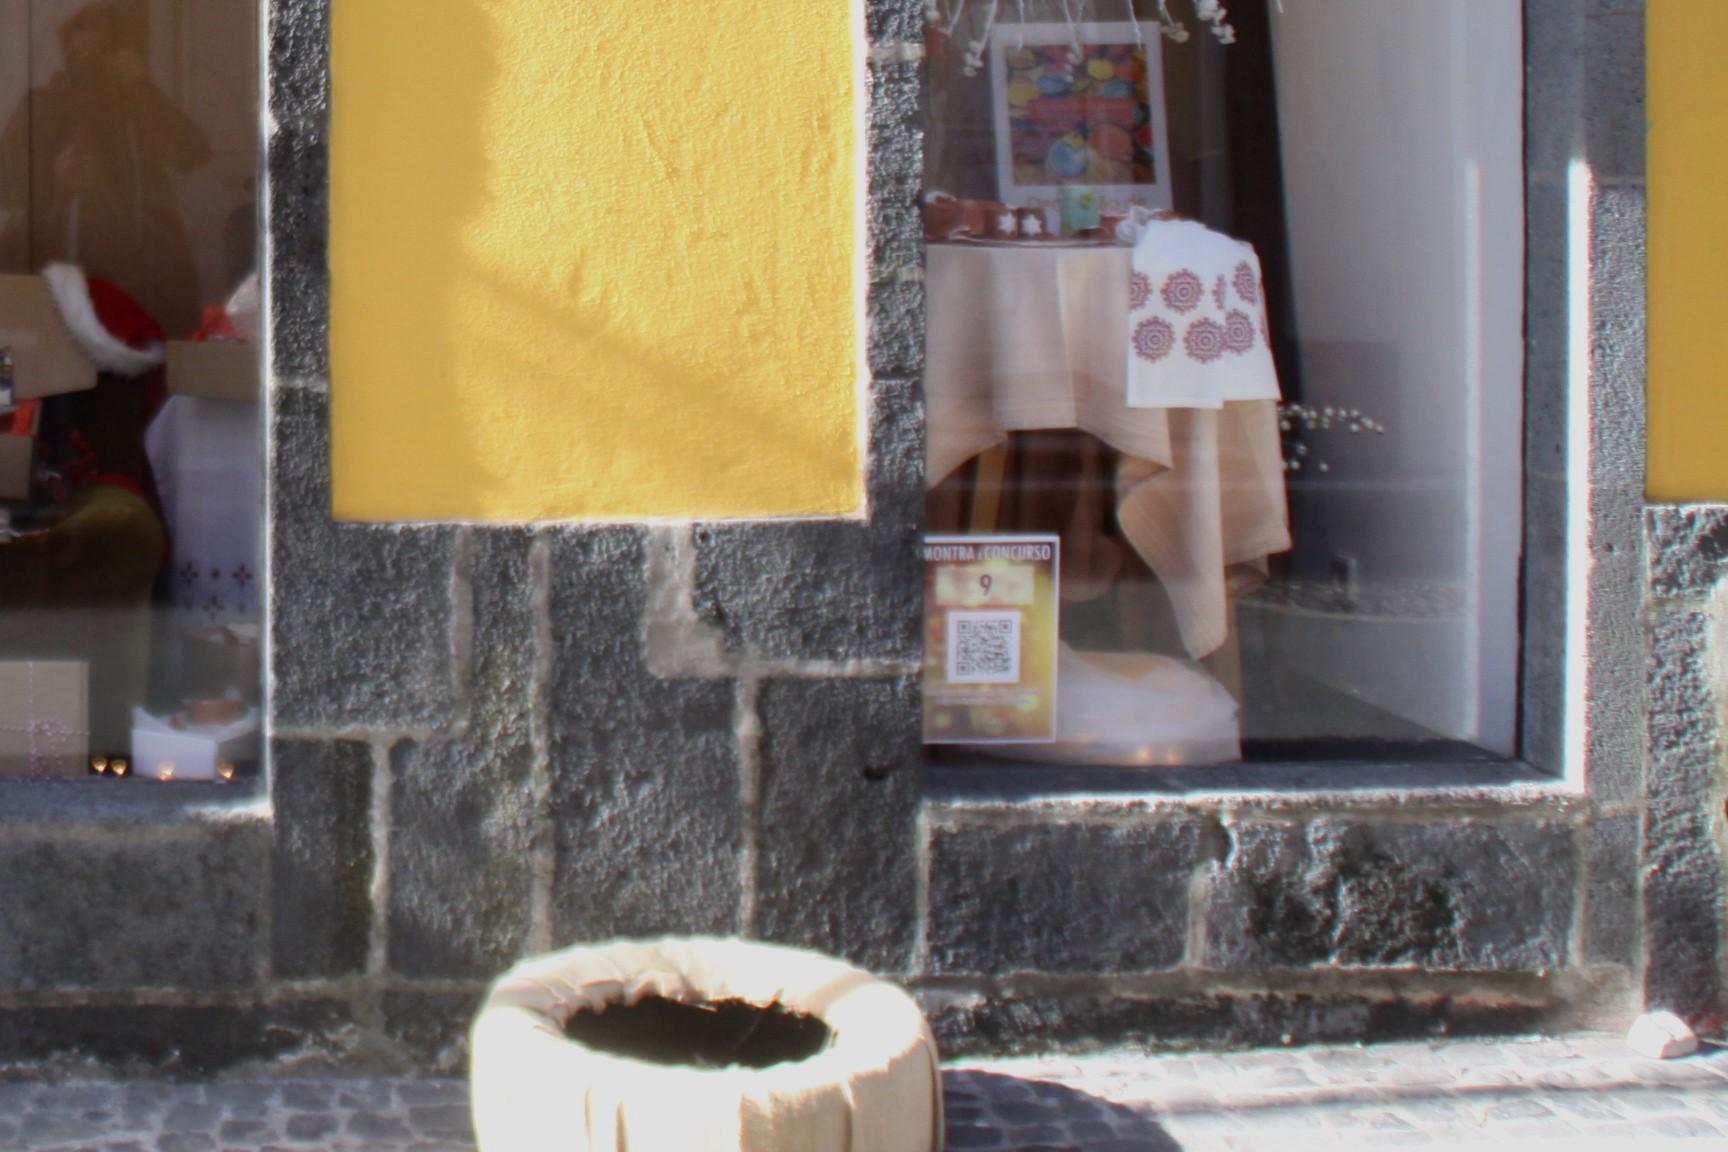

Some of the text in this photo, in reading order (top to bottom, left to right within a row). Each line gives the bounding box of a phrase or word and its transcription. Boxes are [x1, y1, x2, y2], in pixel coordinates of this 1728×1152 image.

[924, 545, 975, 561] MONTRA
[984, 545, 1051, 561] CONCURSO
[979, 574, 992, 596] 9
